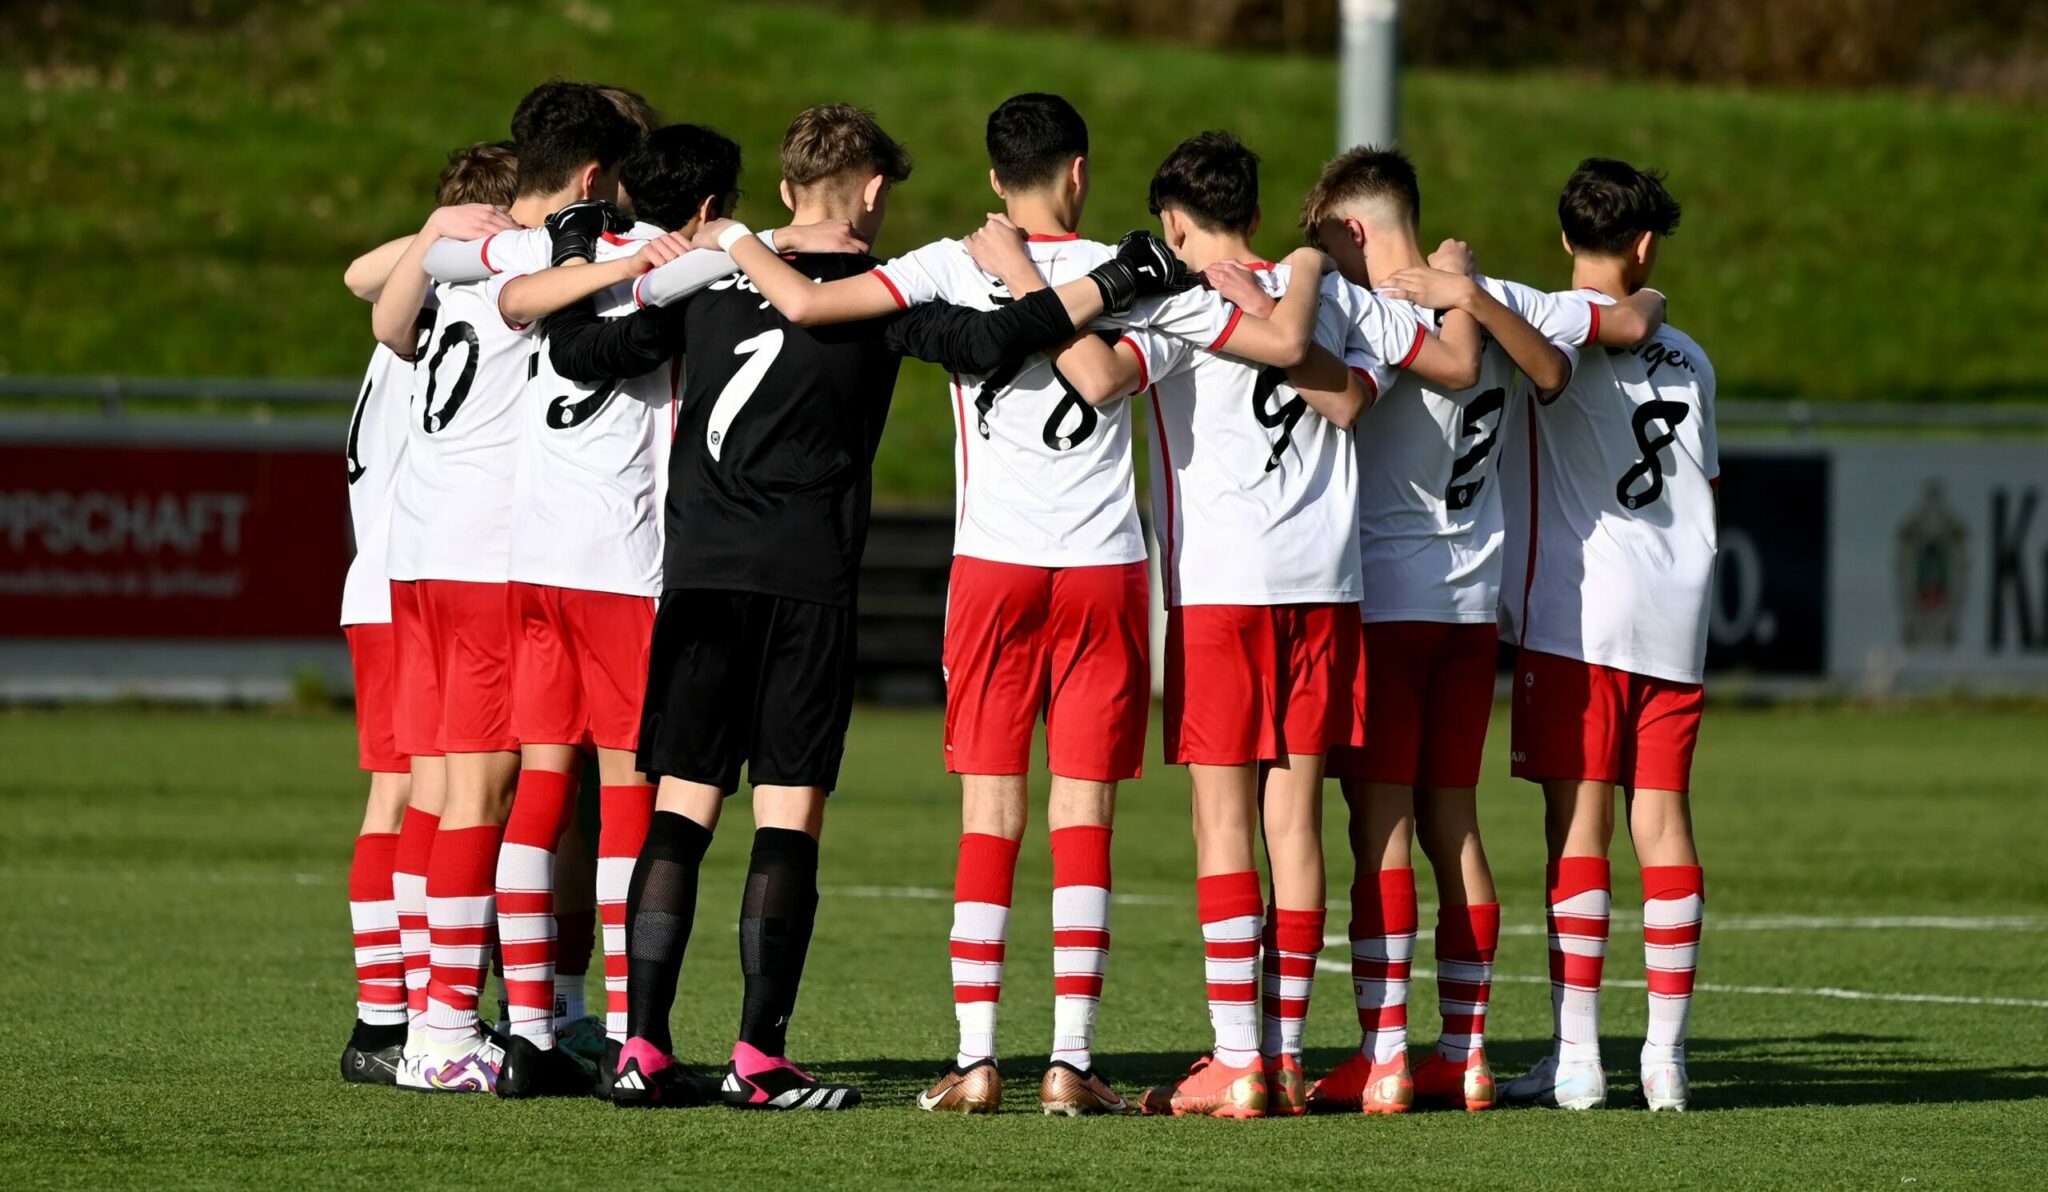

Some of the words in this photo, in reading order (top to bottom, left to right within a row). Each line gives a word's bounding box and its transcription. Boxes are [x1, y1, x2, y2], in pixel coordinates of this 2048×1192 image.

[707, 328, 784, 462] 1
[1445, 387, 1505, 510] 2
[1617, 400, 1689, 510] 8
[1986, 482, 2048, 656] K
